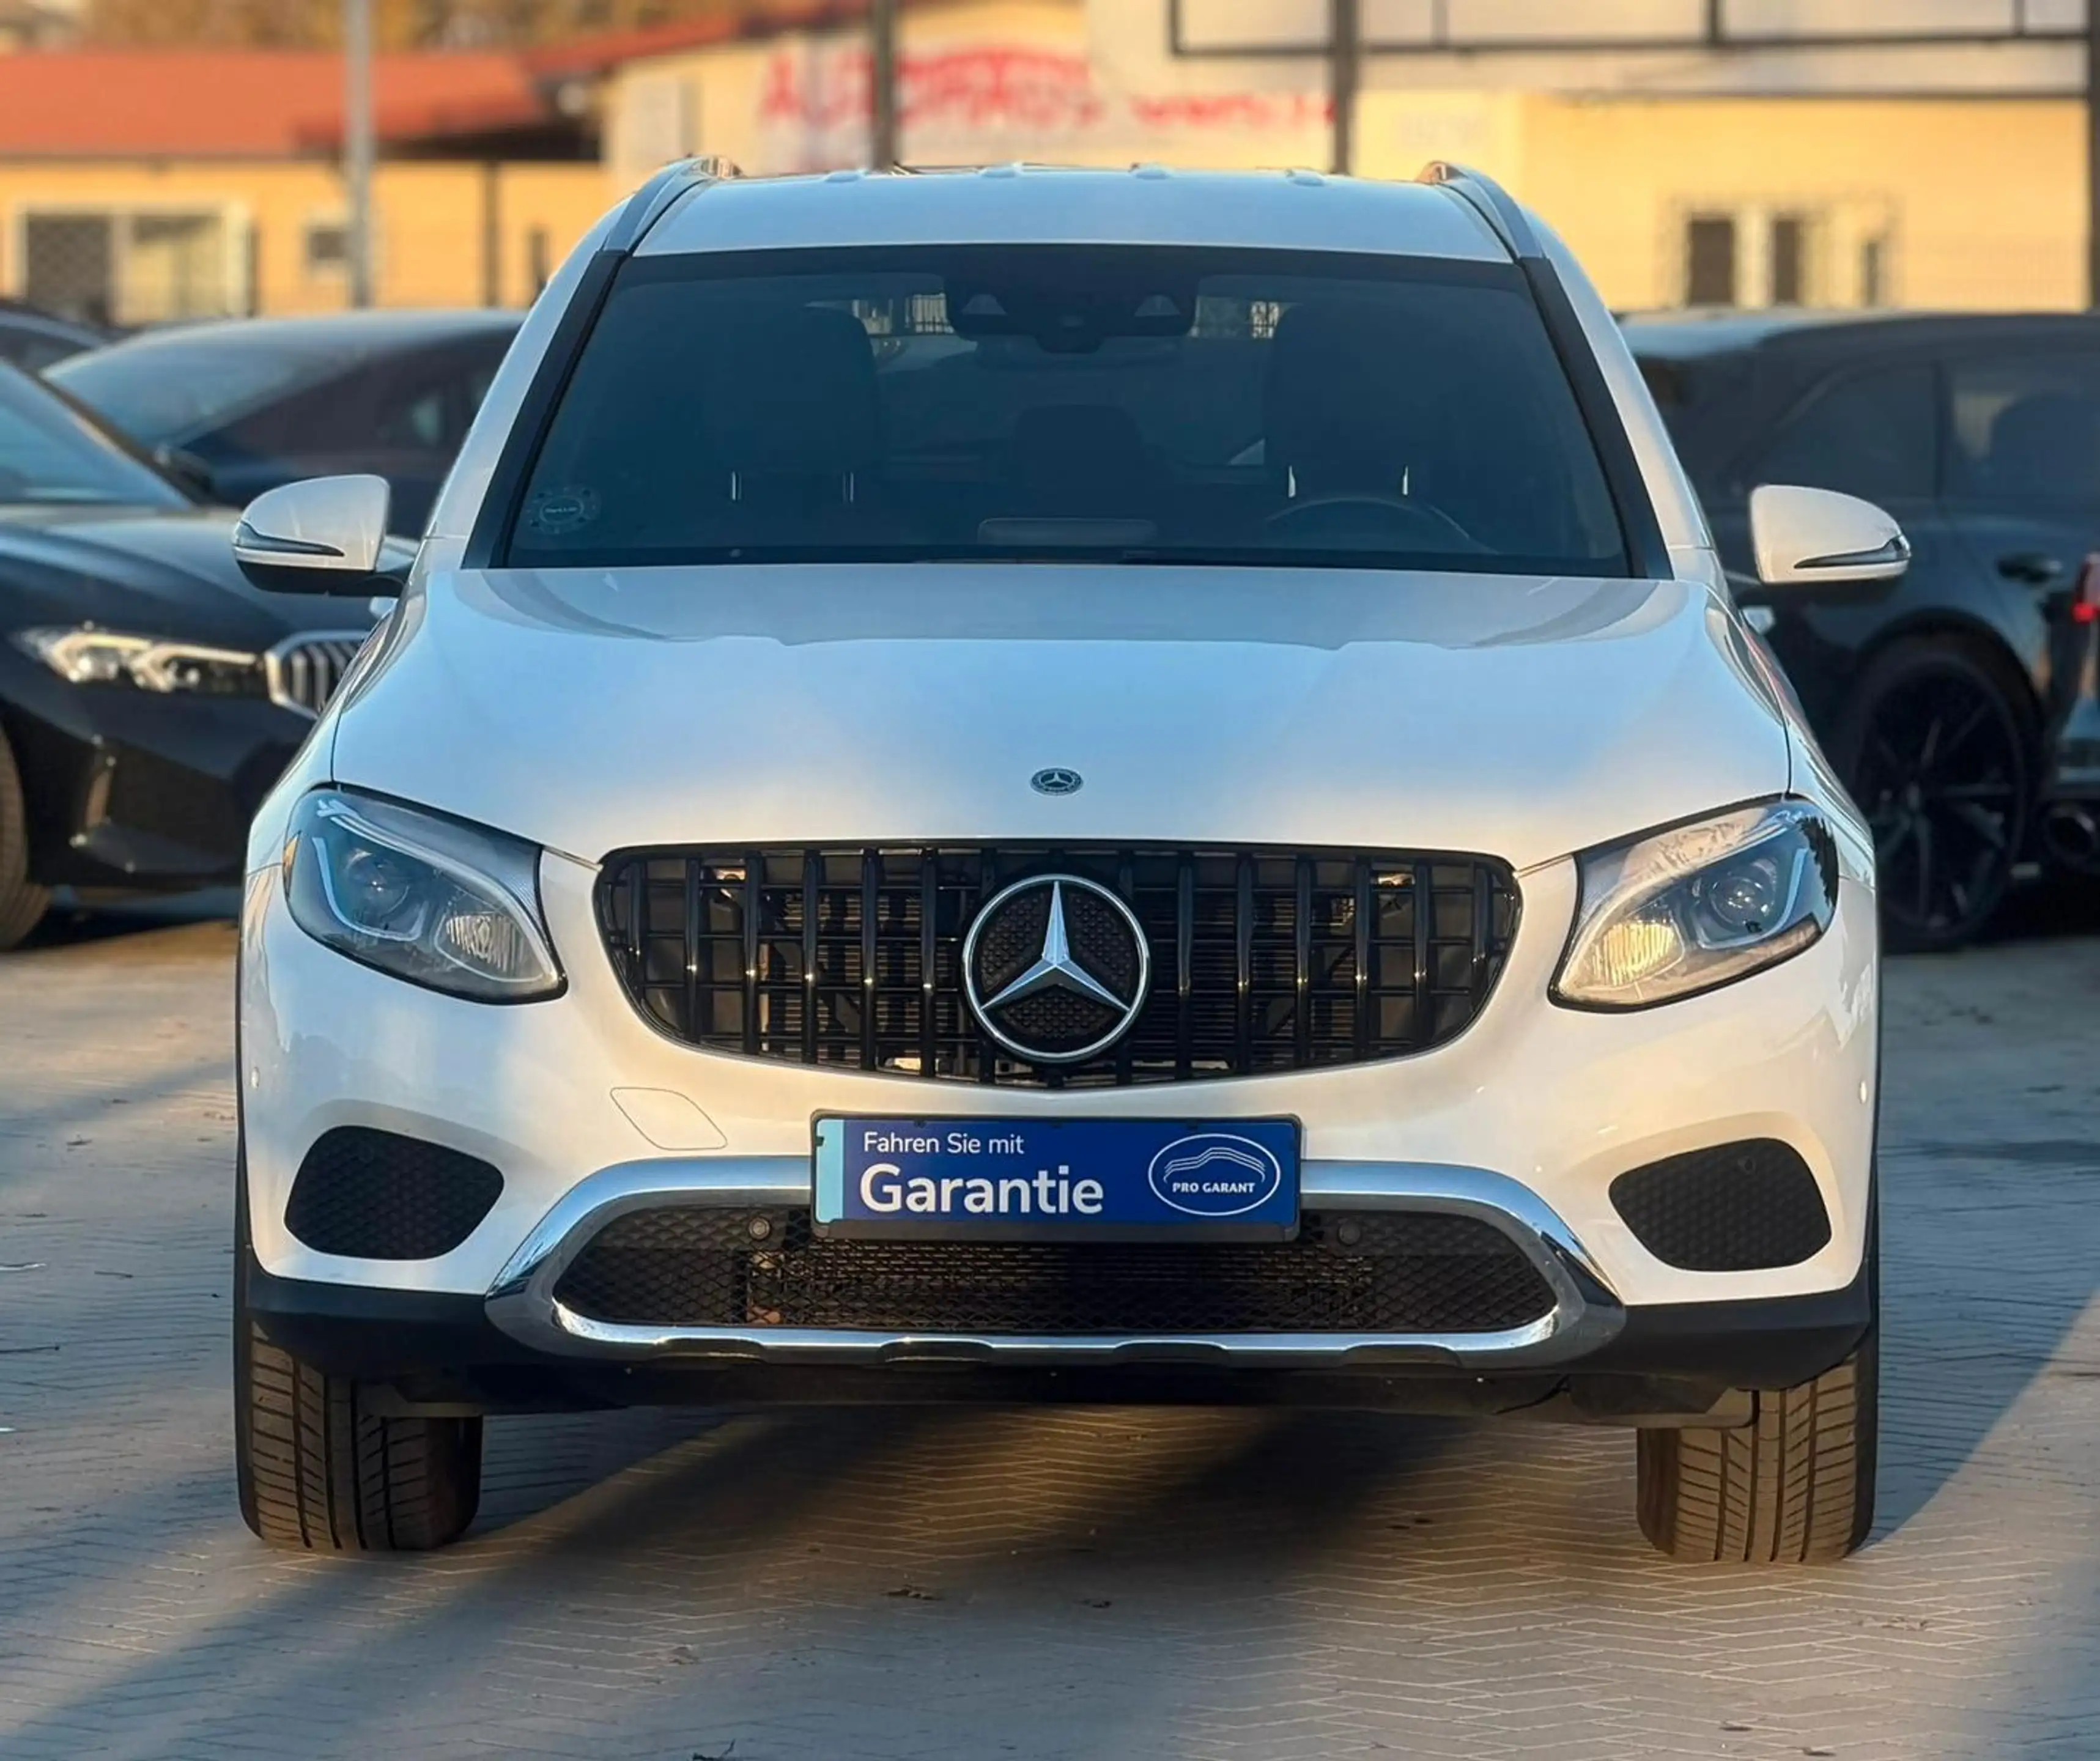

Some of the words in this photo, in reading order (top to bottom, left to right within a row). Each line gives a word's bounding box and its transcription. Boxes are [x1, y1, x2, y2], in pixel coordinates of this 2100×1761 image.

[863, 1131, 940, 1153] Fahren
[947, 1132, 982, 1154] Sie
[988, 1133, 1024, 1154] mit
[860, 1163, 1103, 1213] Garantie
[1172, 1182, 1199, 1193] PRO
[1202, 1182, 1255, 1193] GARANT
